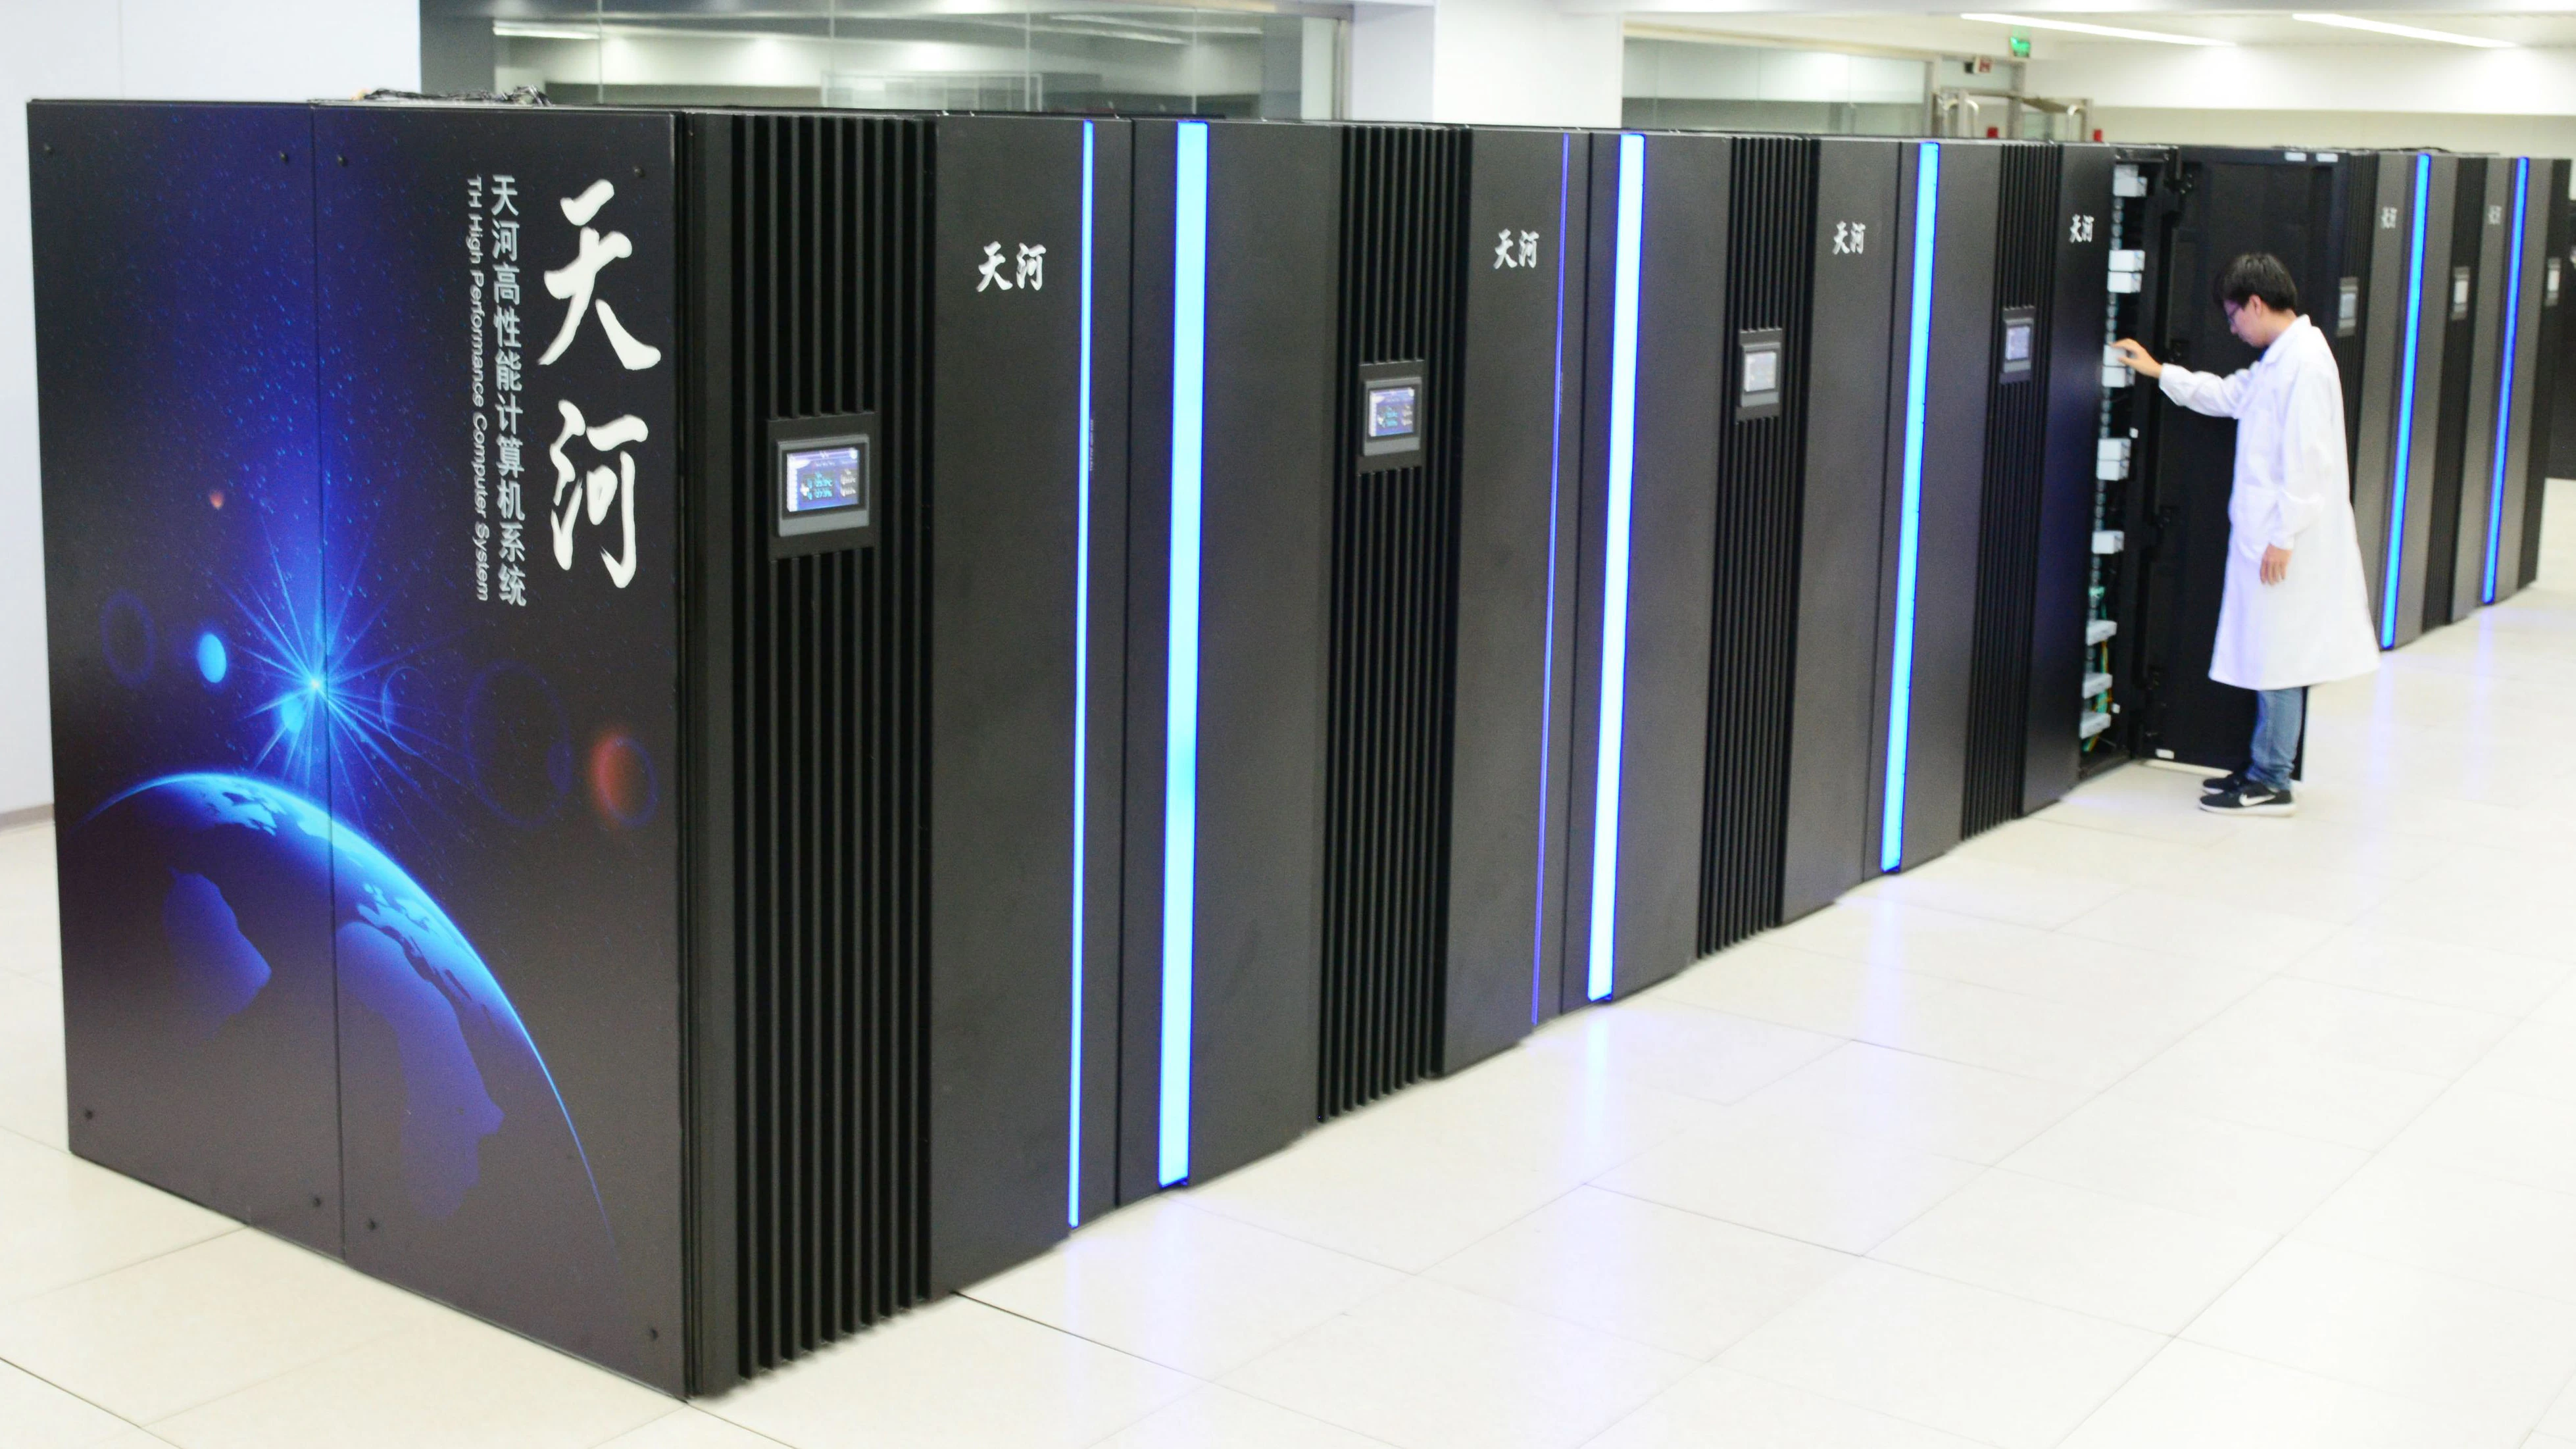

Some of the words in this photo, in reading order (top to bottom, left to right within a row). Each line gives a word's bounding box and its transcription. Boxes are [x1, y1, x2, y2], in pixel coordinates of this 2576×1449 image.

[467, 174, 482, 208] TH
[466, 213, 483, 264] High
[1493, 228, 1540, 270] 天河
[1832, 220, 1866, 255] 天河
[2068, 214, 2094, 243] 天河
[976, 241, 1047, 292] 天河
[470, 269, 485, 407] Performance
[491, 174, 526, 606] 天河高性能计算机系统
[537, 179, 661, 589] 天河
[471, 411, 488, 518] Computer
[472, 521, 489, 601] System
